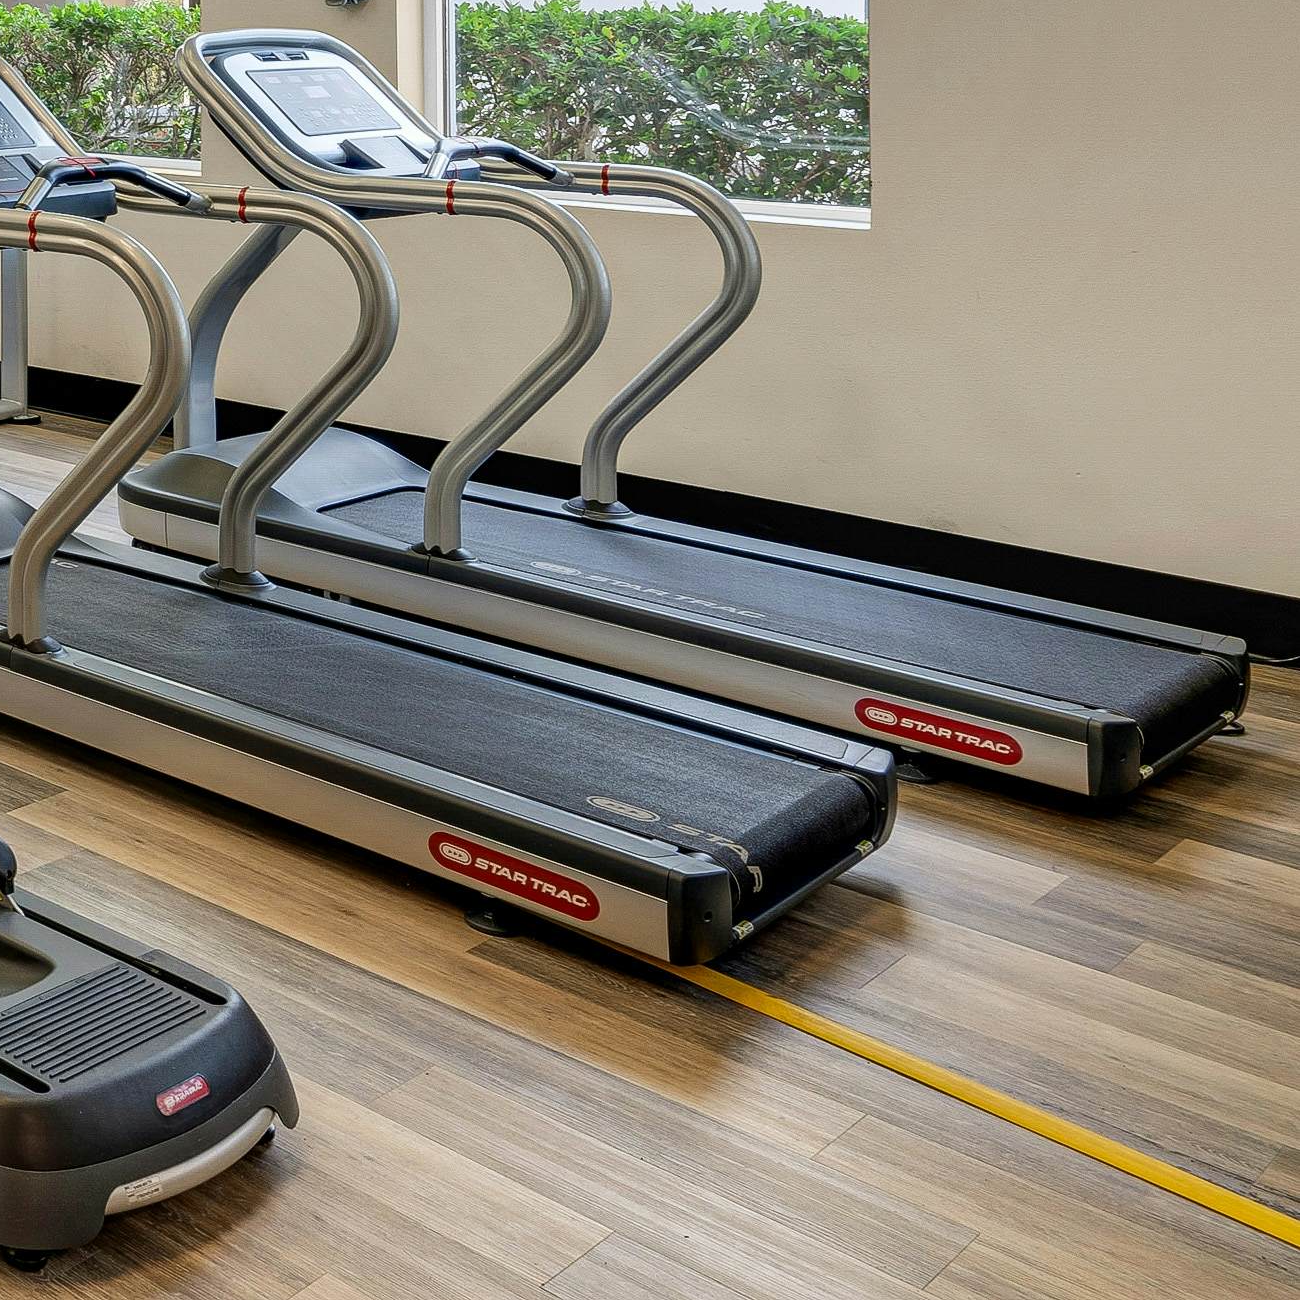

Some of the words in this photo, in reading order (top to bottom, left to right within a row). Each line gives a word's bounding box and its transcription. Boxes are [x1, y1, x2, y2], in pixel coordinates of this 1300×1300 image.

[585, 575, 670, 597] STAR
[674, 595, 766, 619] TRAC
[900, 717, 952, 739] STAR
[955, 731, 1011, 754] TRAC
[475, 857, 527, 886] STAR
[530, 877, 588, 908] TRAC
